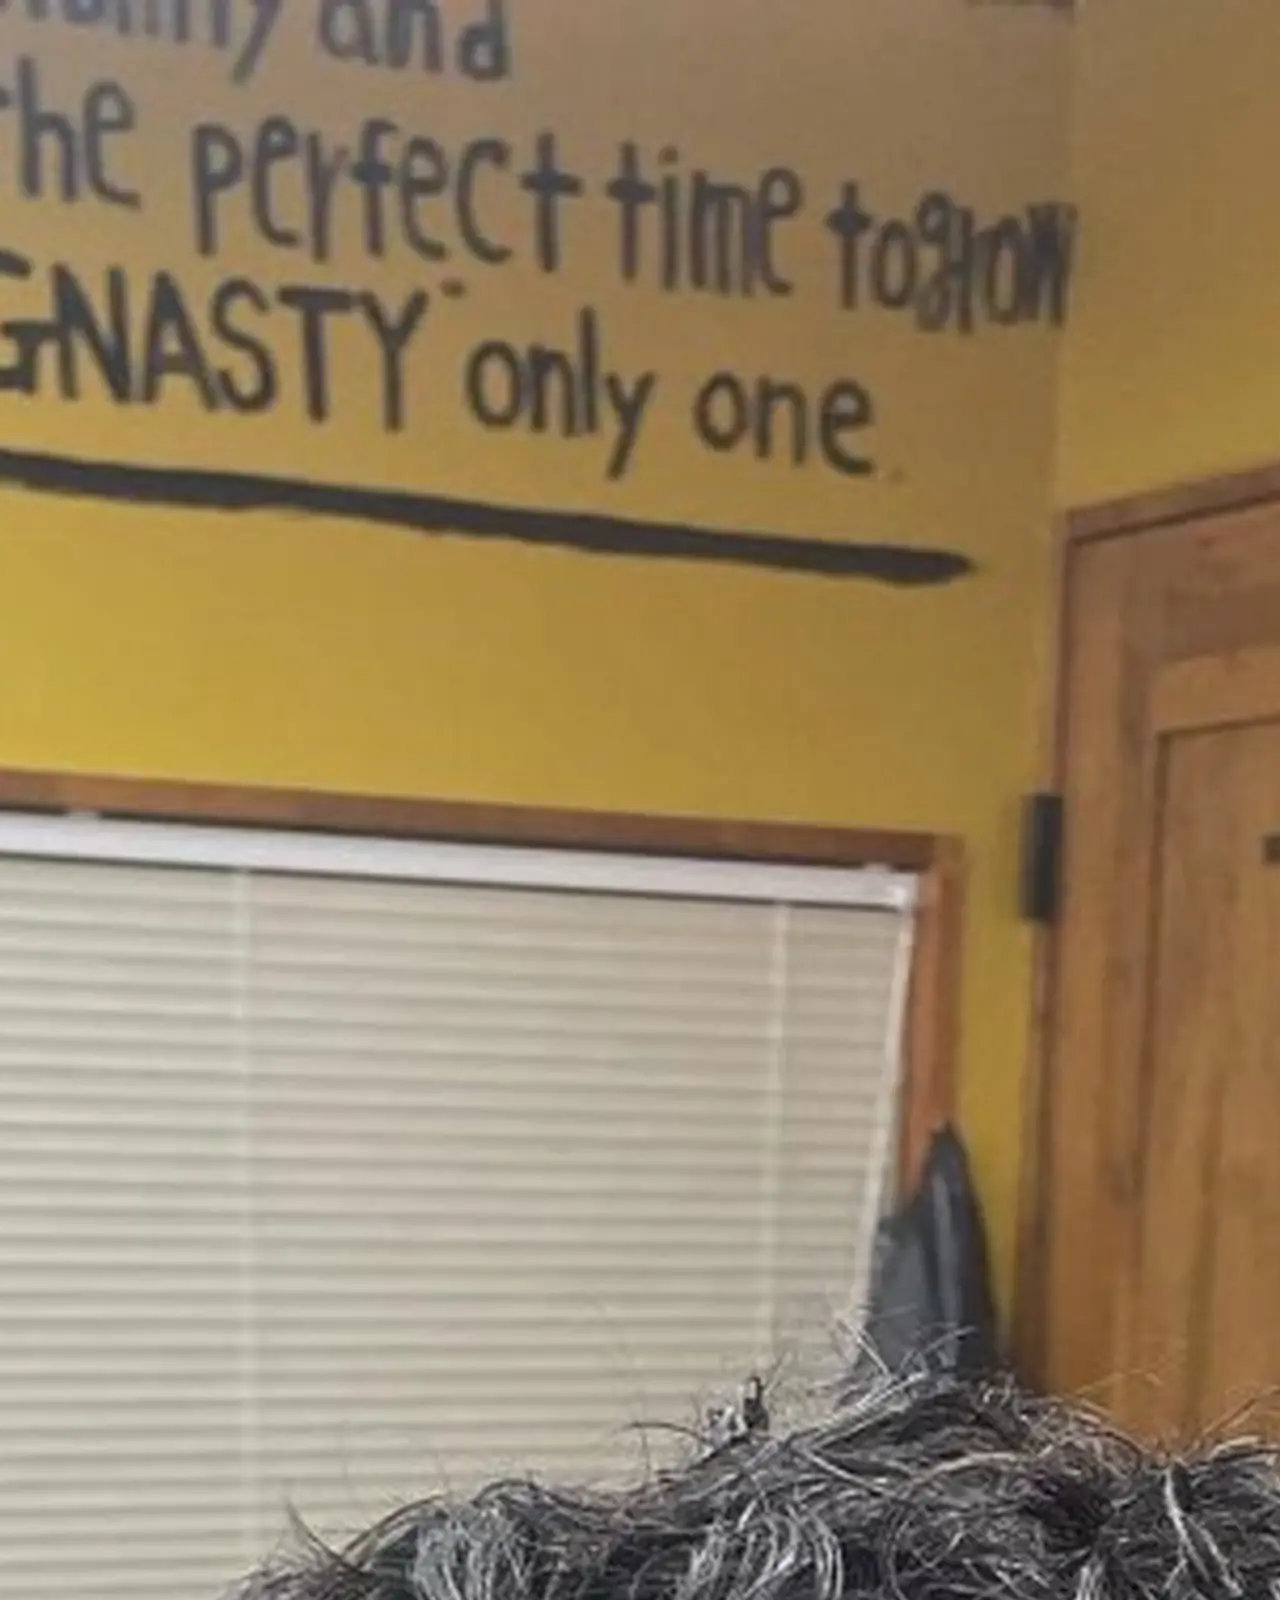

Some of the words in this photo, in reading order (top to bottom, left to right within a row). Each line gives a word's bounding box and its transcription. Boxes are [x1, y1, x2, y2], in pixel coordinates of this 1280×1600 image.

[317, 0, 510, 81] and
[193, 117, 582, 273] perfect
[607, 143, 803, 297] time
[465, 305, 655, 480] only
